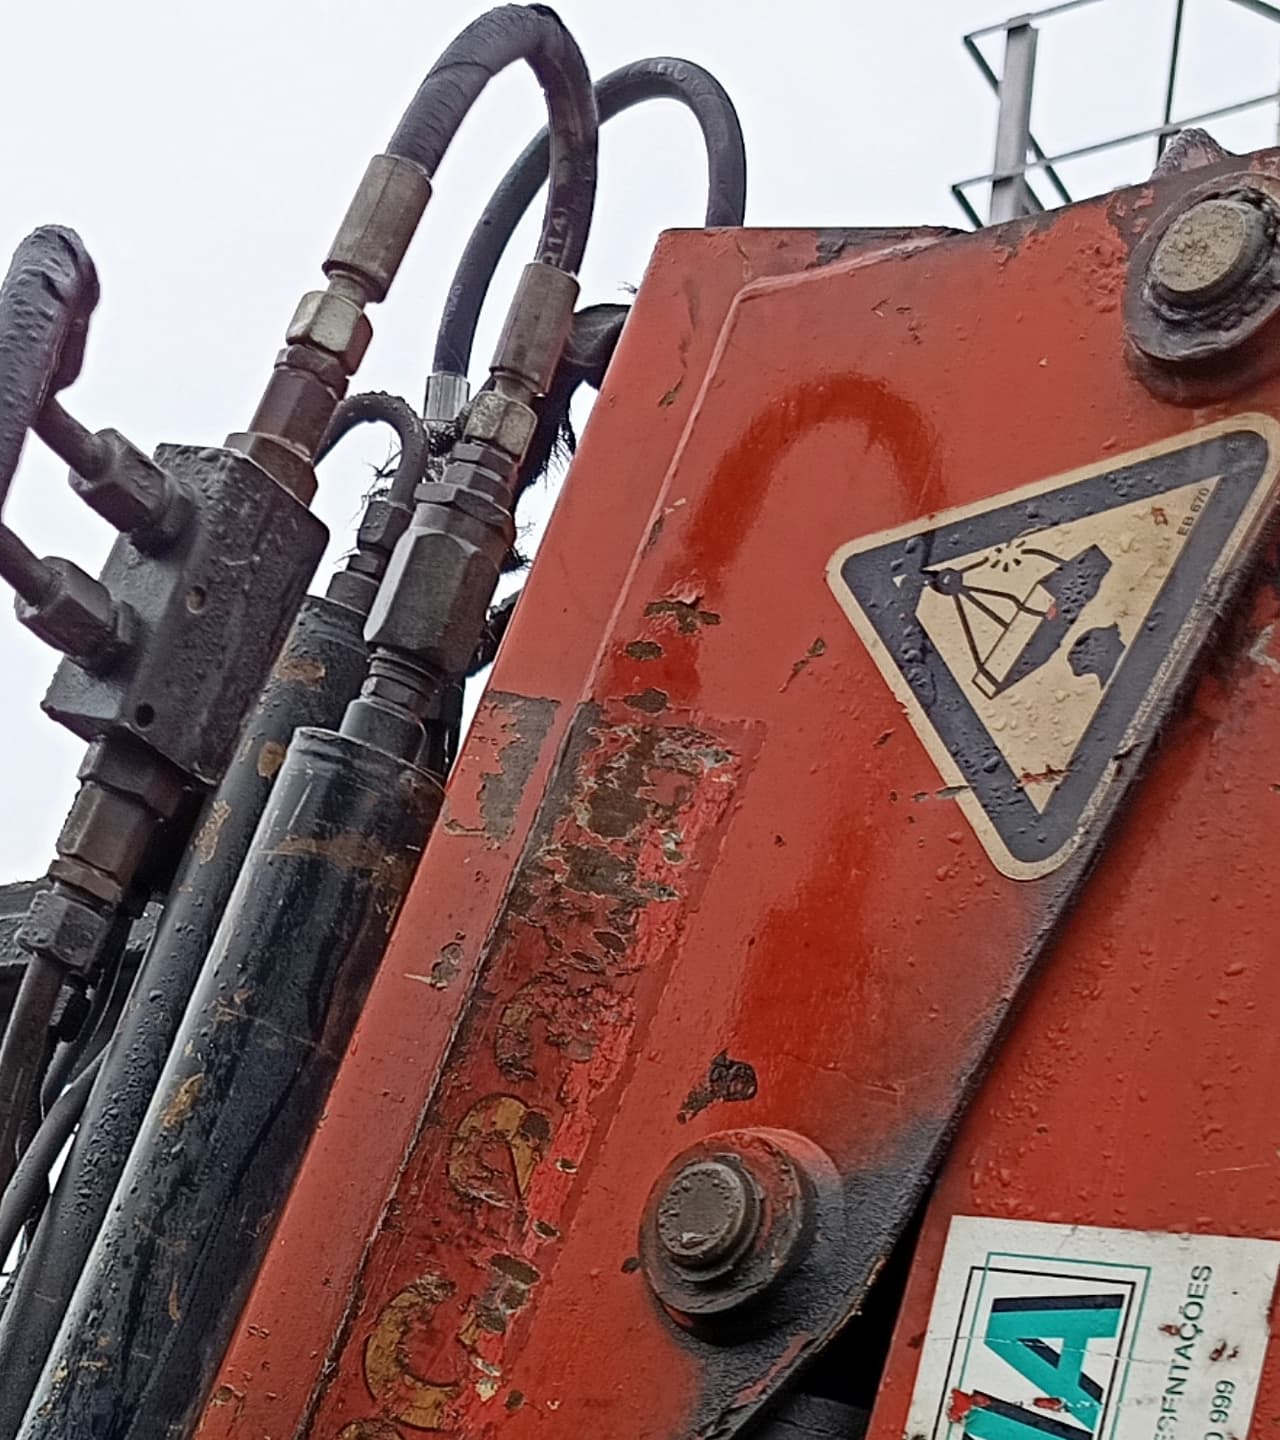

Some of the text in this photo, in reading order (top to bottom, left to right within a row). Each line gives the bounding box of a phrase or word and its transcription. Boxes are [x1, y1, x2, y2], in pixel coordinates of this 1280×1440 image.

[1176, 487, 1210, 536] EB 670
[1210, 1379, 1236, 1425] 999
